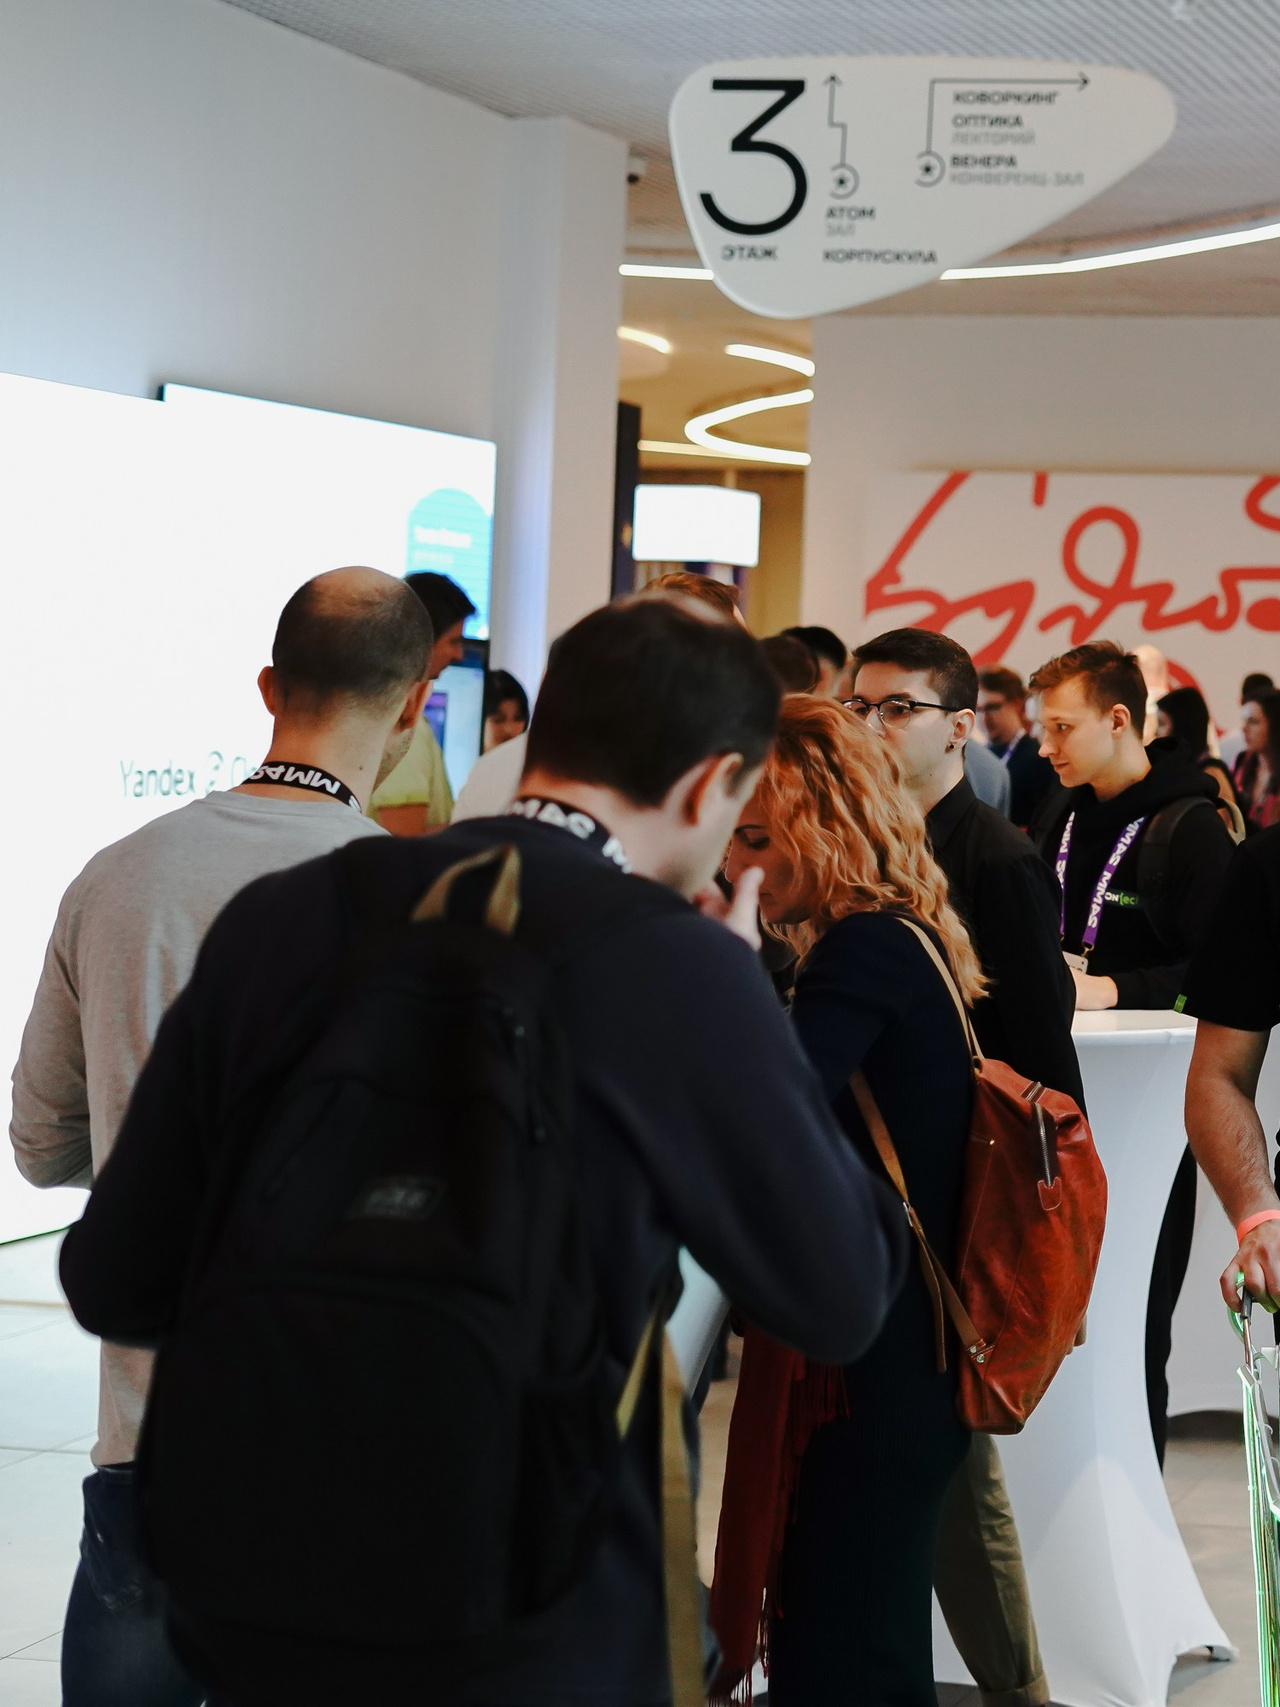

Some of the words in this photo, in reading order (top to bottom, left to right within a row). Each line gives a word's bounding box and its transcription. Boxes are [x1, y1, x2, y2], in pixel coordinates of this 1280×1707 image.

[953, 91, 1058, 105] КОВОРКИНГ
[952, 114, 1023, 128] ОПТИКА
[700, 79, 807, 236] 3
[951, 154, 1018, 168] ВЕНЕРА
[826, 206, 875, 221] АТОМ
[722, 245, 778, 261] ЭТАЖ
[823, 249, 938, 264] КОРПУСКУЛА
[119, 759, 196, 798] Yandex
